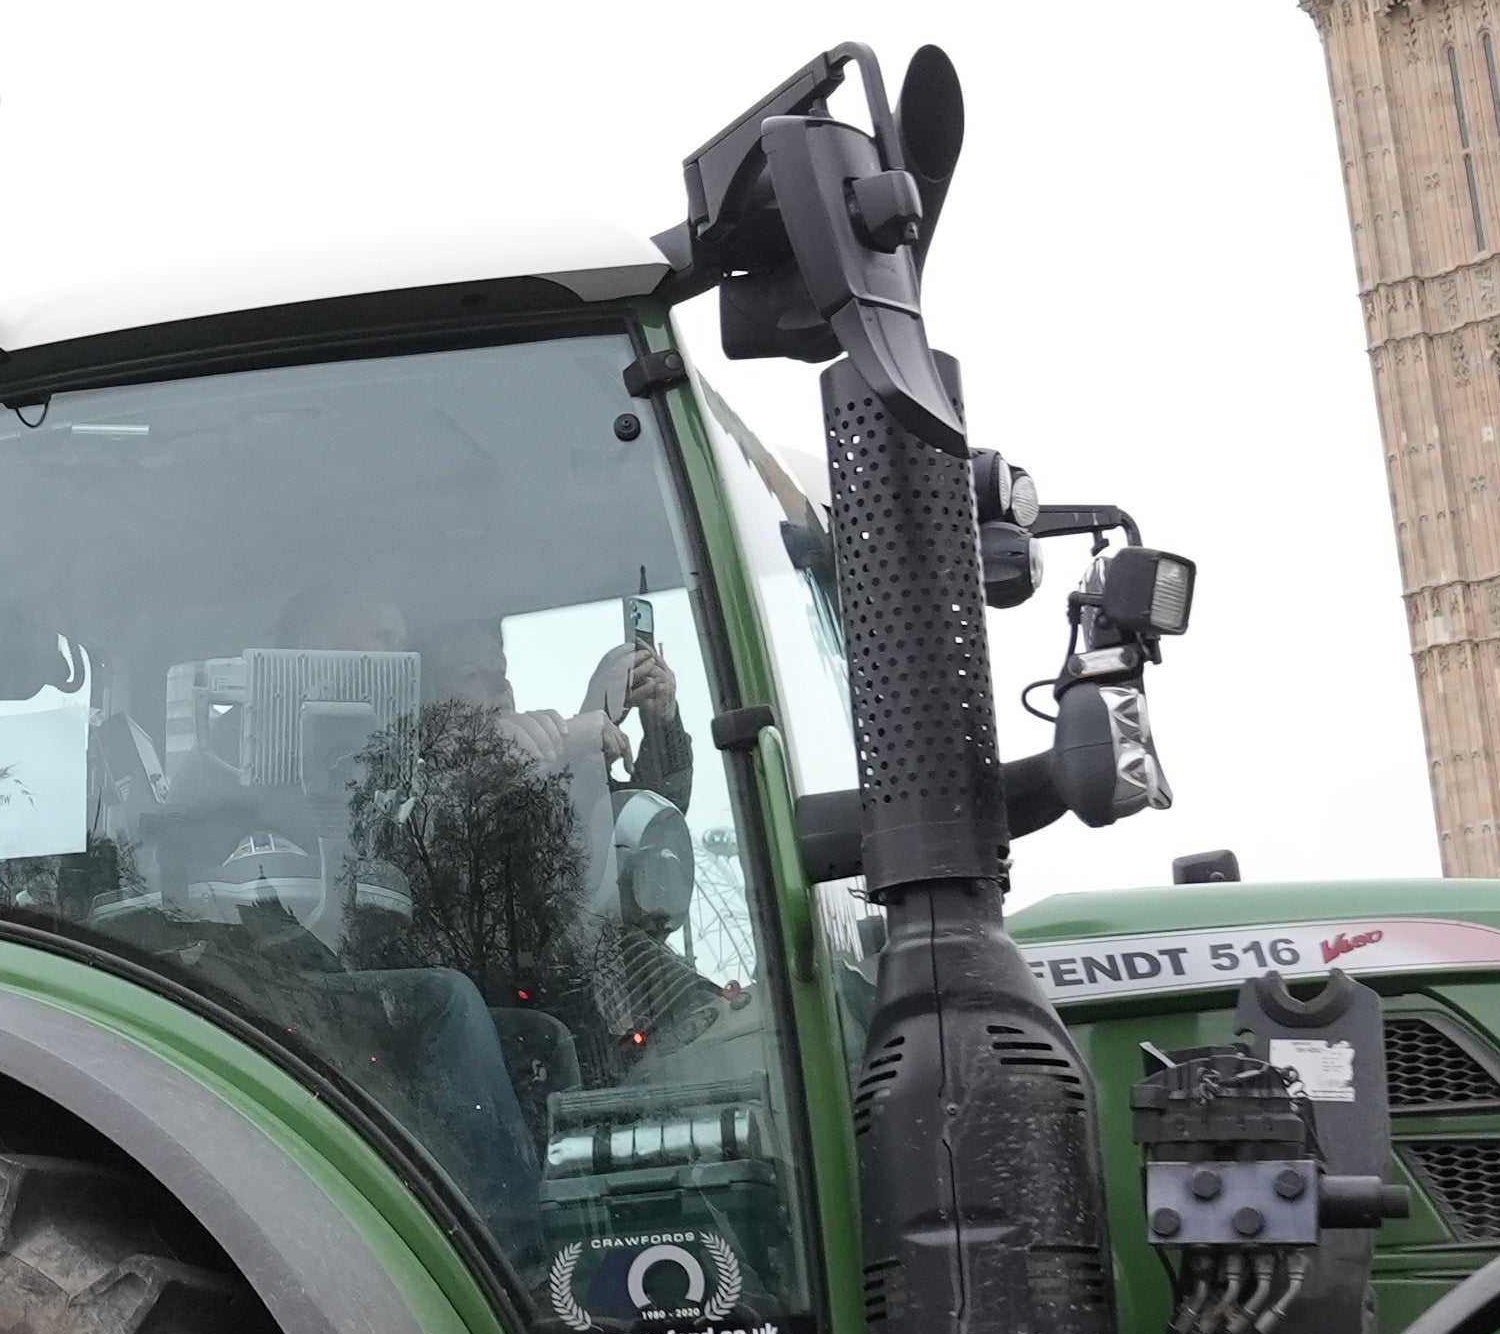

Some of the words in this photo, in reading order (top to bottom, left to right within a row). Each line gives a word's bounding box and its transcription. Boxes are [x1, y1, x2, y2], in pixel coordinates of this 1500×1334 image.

[1208, 937, 1301, 971] 516
[590, 1231, 696, 1250] CRAWFORDS
[641, 1309, 666, 1321] 1980
[674, 1307, 701, 1319] 2020
